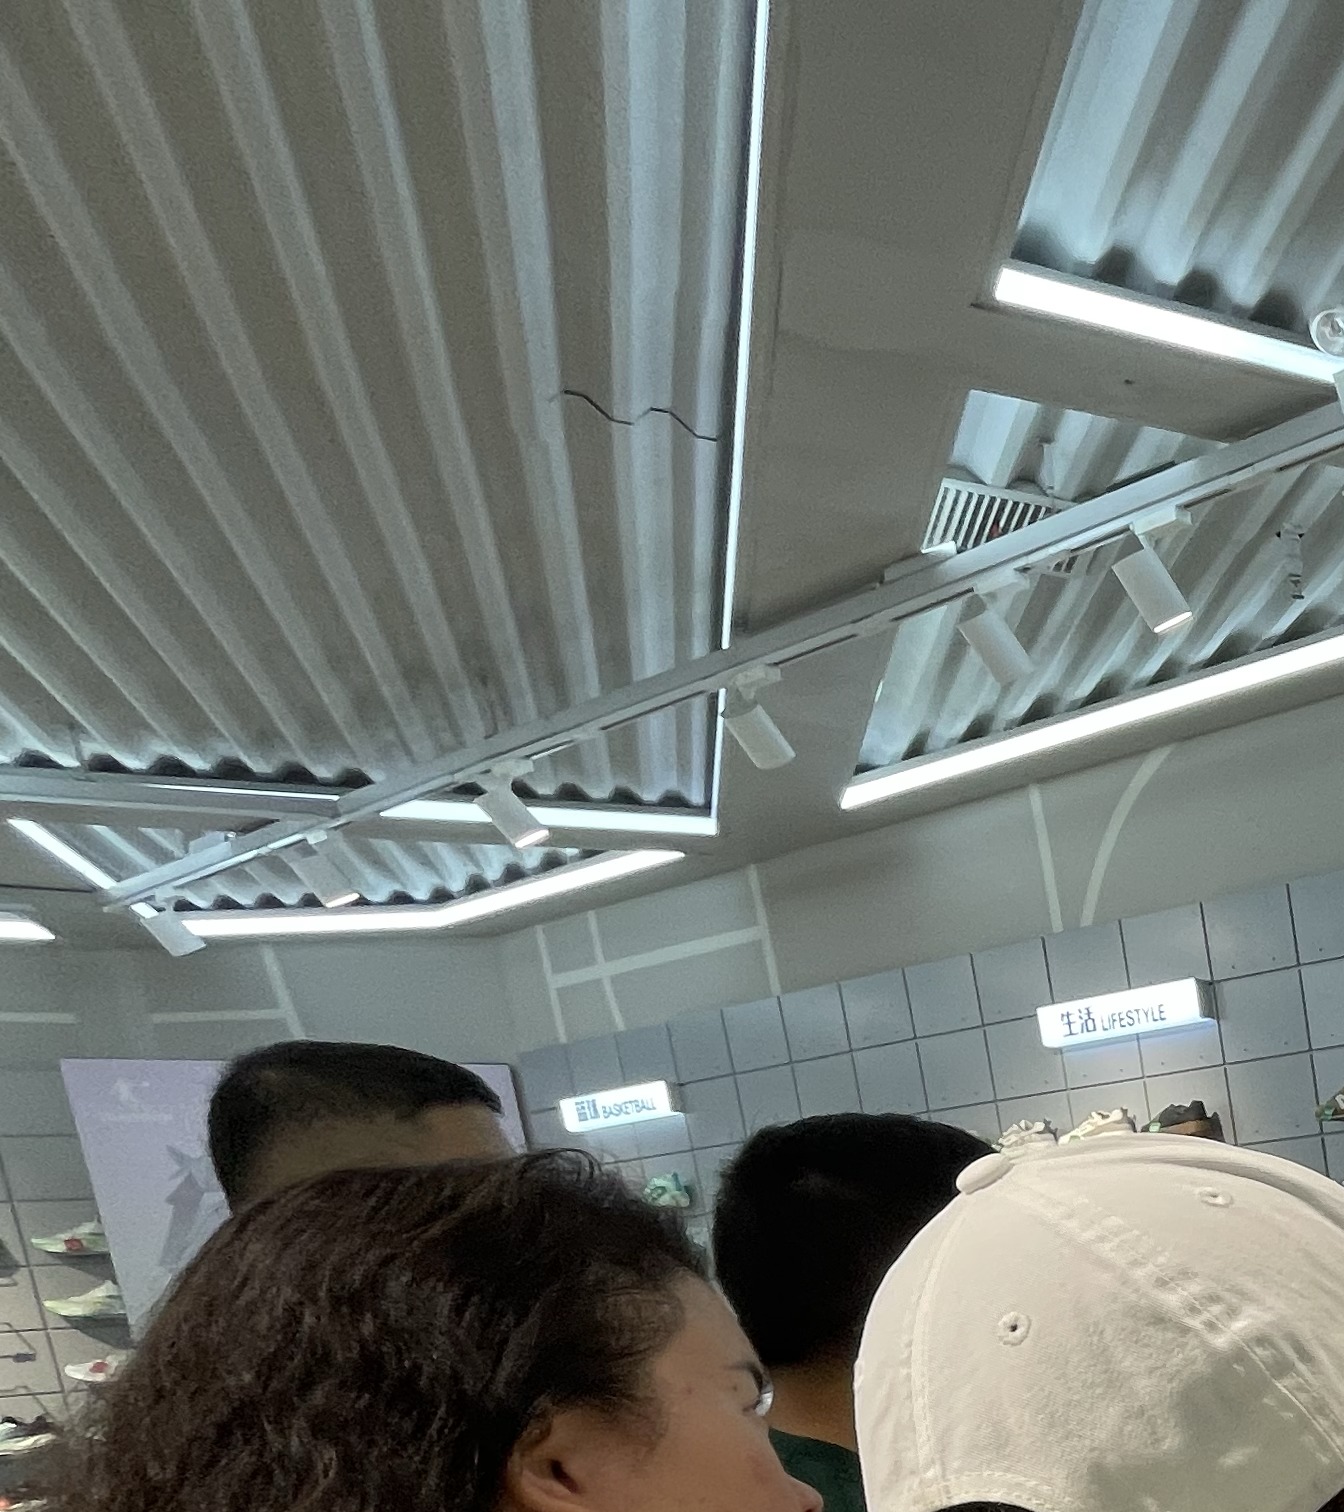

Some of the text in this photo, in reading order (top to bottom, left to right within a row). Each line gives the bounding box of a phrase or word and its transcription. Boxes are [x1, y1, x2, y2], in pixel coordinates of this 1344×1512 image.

[1060, 1004, 1167, 1037] 生活 LIFESTYLE
[602, 1098, 657, 1119] BASKETBALL
